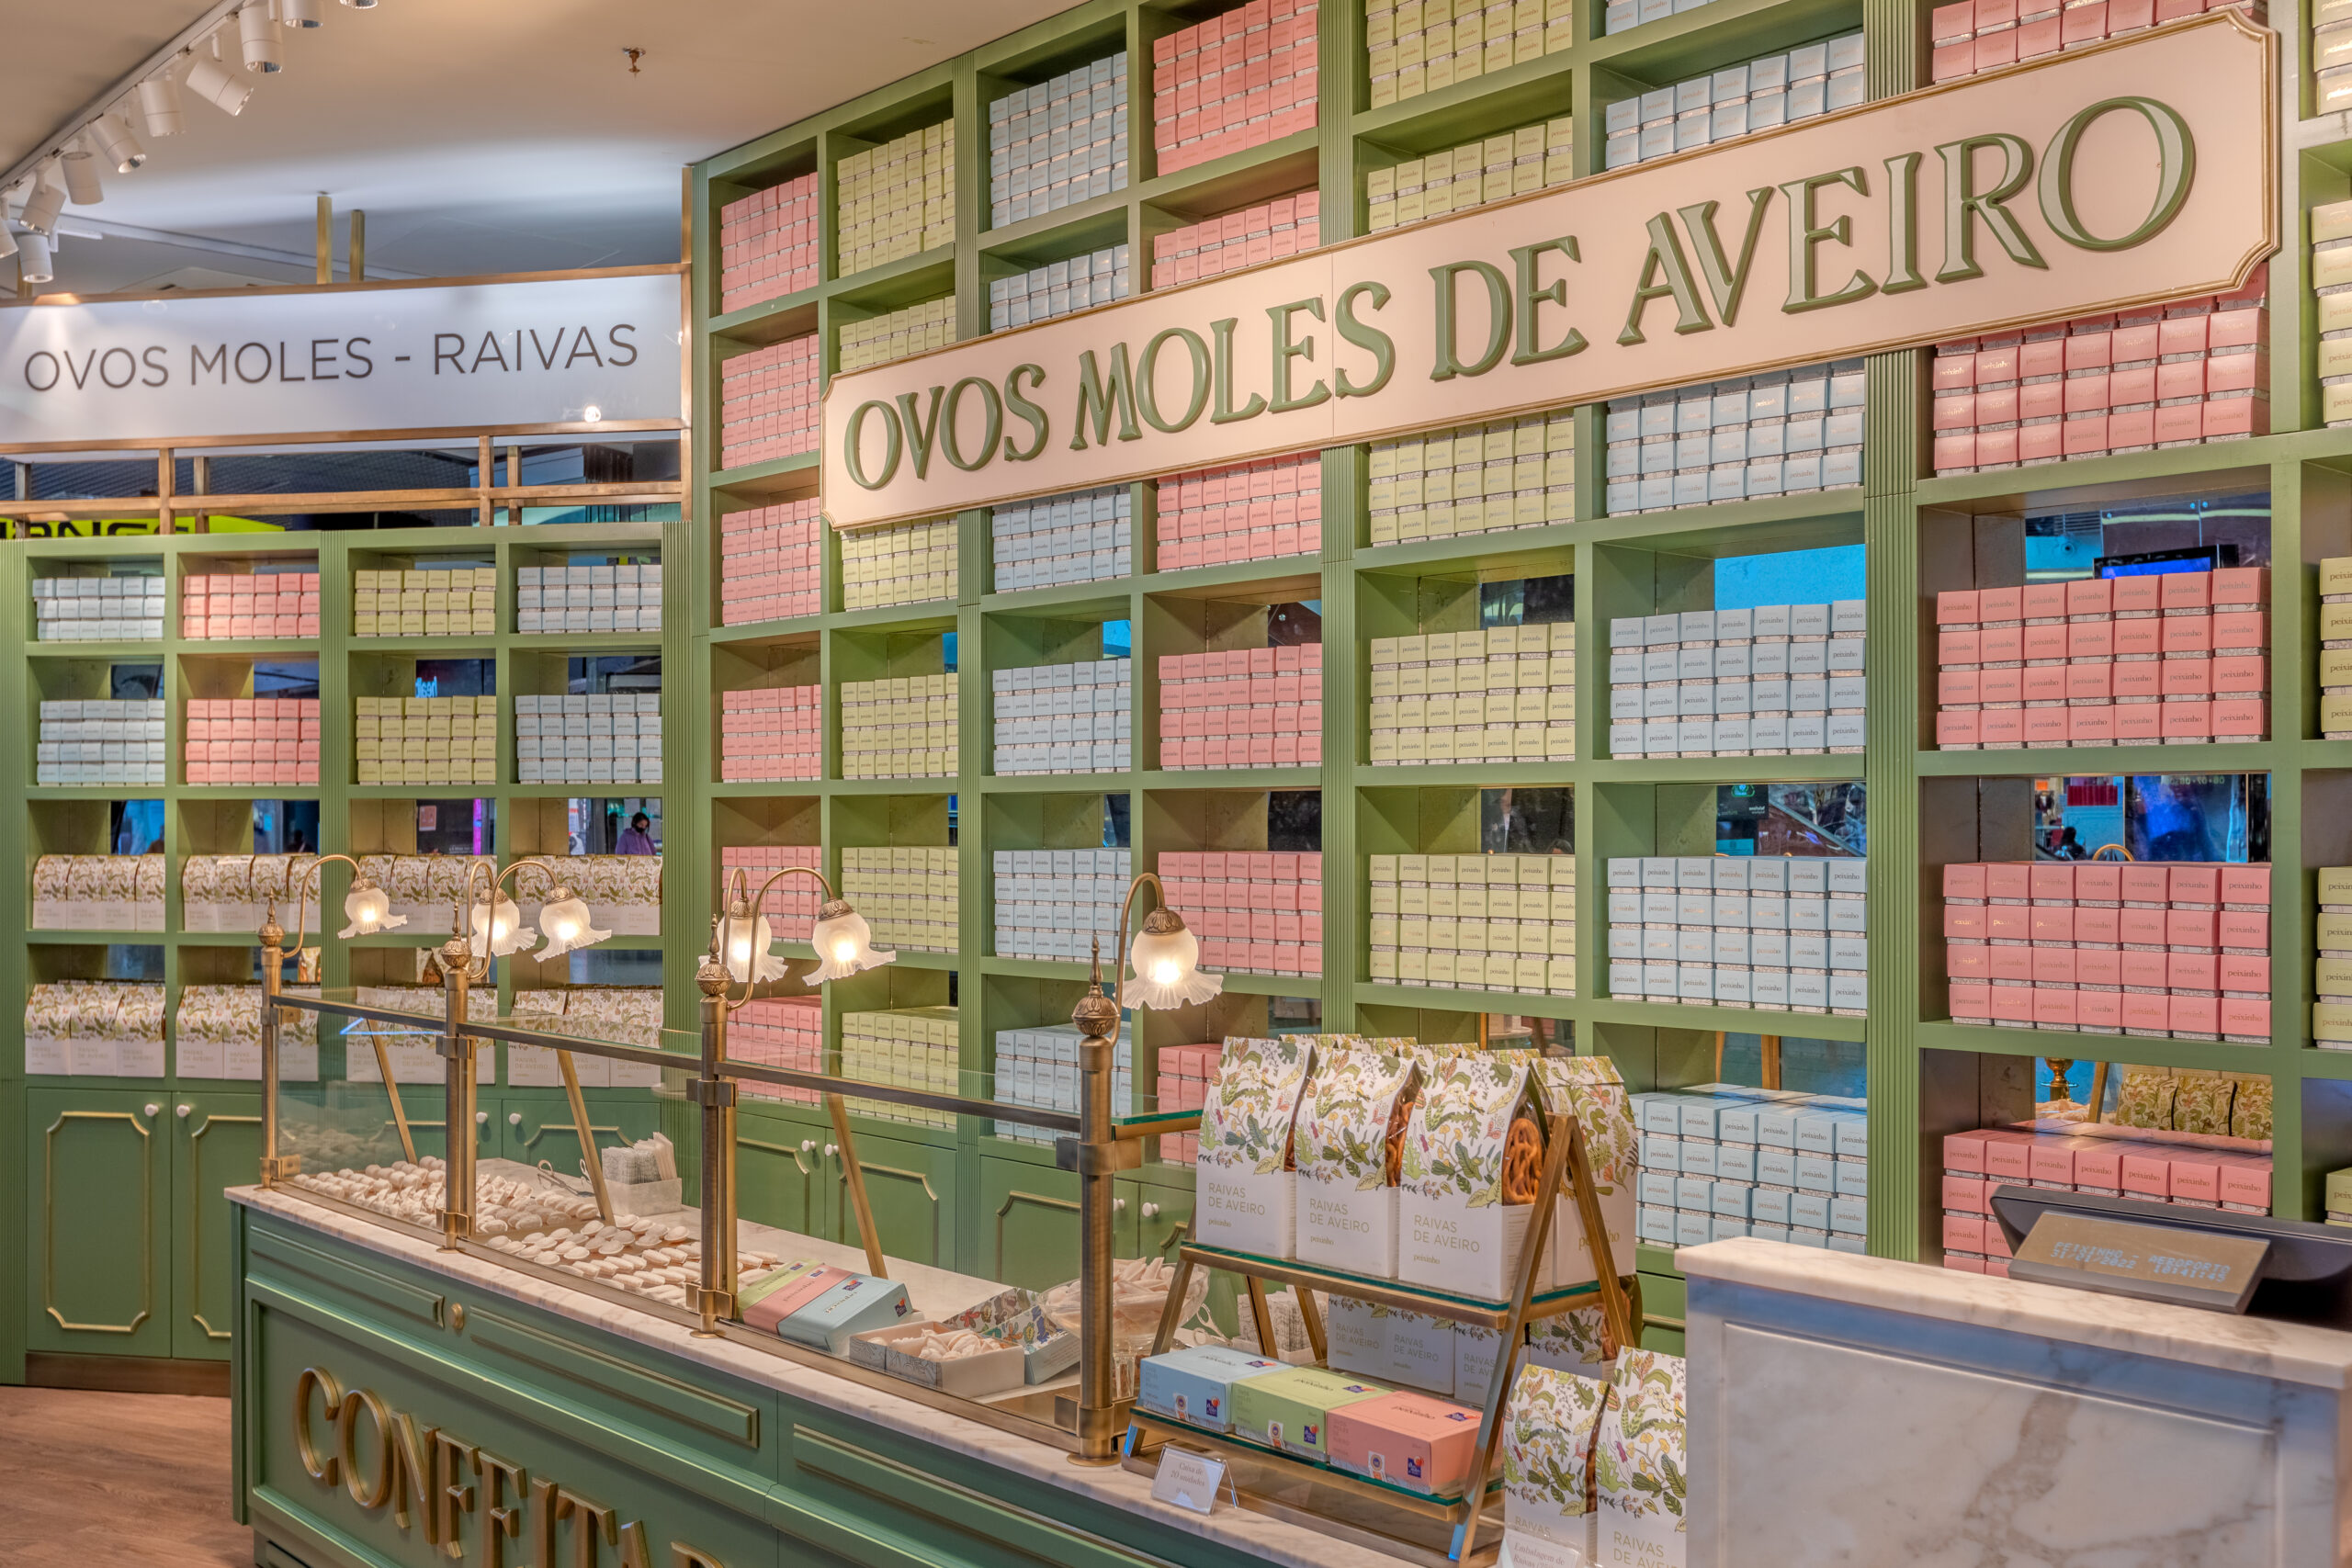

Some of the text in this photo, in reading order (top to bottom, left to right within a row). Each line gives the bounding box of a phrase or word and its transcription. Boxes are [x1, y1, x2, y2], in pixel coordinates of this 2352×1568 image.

[843, 364, 1048, 492] OVOS
[1070, 281, 1395, 451] MOLES
[1429, 235, 1588, 380] DE
[1616, 96, 2197, 347] AVEIRO
[25, 345, 168, 392] OVOS
[191, 336, 374, 387] MOLES
[434, 322, 639, 375] RAIVAS
[1949, 1151, 1978, 1159] peixinho
[2036, 1161, 2066, 1169] peixinho
[2129, 1172, 2160, 1180] peixinho
[2177, 1178, 2210, 1186] peixinho
[1208, 1182, 1246, 1198] RAIVAS
[2228, 1183, 2261, 1191] peixinho
[1208, 1196, 1265, 1216] DE AVEIRO
[1309, 1198, 1349, 1215] RAIVAS
[1797, 1208, 1821, 1216] peixinho
[1309, 1213, 1370, 1234] DE AVEIRO
[1414, 1214, 1457, 1233] RAIVAS
[1413, 1230, 1480, 1253] DE AVEIRO
[1413, 1253, 1441, 1265] peixinho
[2054, 1242, 2123, 1258] PEIXINHO
[2148, 1255, 2231, 1273] AEROPORTO
[1336, 1322, 1364, 1337] RAIVAS
[1336, 1332, 1379, 1349] DE AVEIRO
[1394, 1334, 1423, 1348] RAIVAS
[1394, 1345, 1440, 1362] DE AVEIRO
[1464, 1353, 1496, 1368] RAIVAS
[1464, 1363, 1476, 1374] DE
[294, 1367, 726, 1568] CONFEIT
[1514, 1543, 1555, 1562] Embalagem
[1613, 1530, 1664, 1558] RAIVAS
[1613, 1548, 1632, 1565] DE
